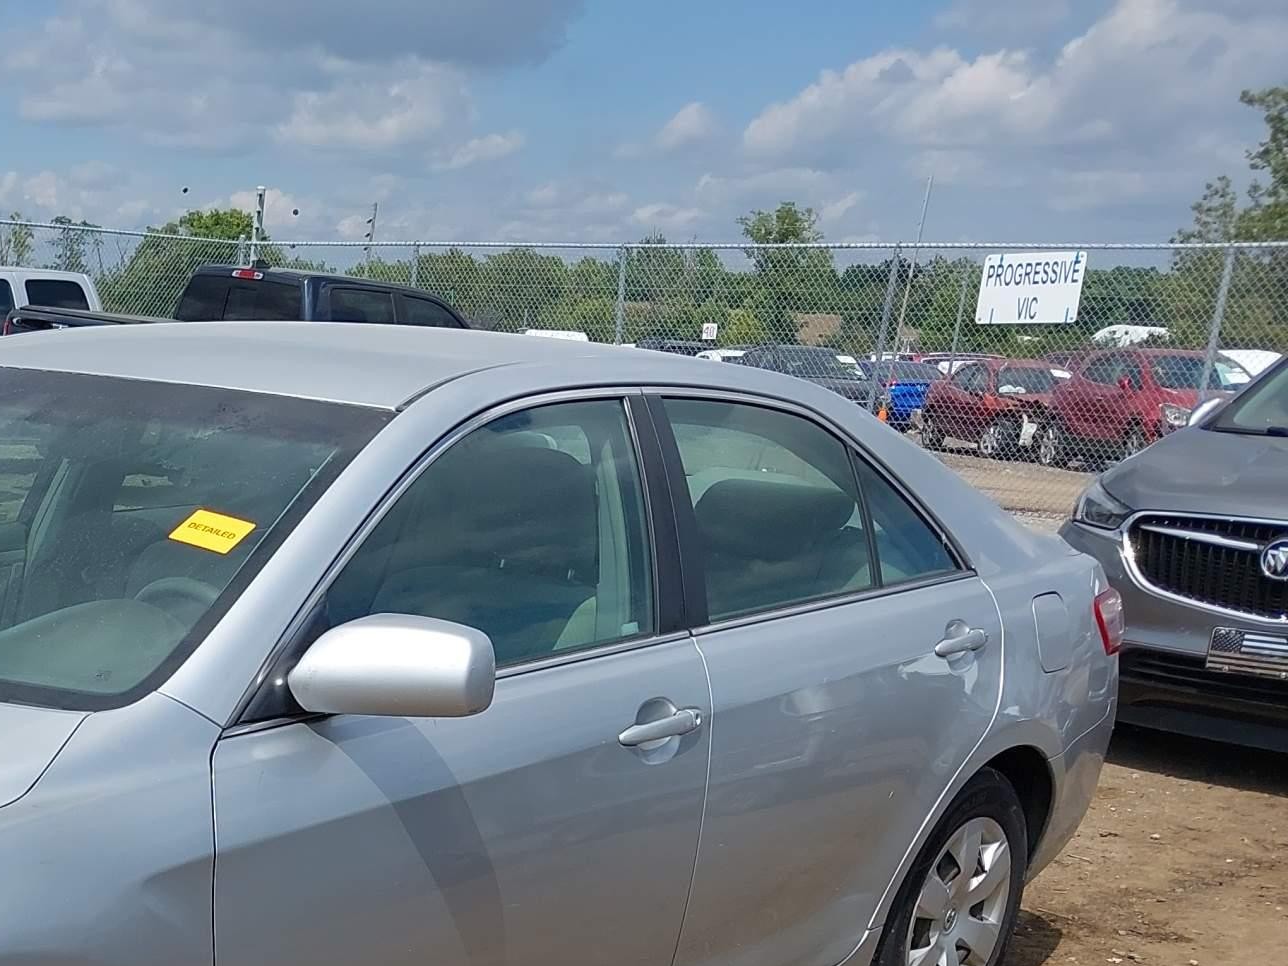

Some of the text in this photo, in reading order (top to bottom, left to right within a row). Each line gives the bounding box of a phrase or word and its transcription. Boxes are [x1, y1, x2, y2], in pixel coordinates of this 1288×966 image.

[985, 260, 1082, 287] PROGRESSIVE
[1017, 297, 1039, 320] VIC
[188, 522, 236, 540] DETAILED
